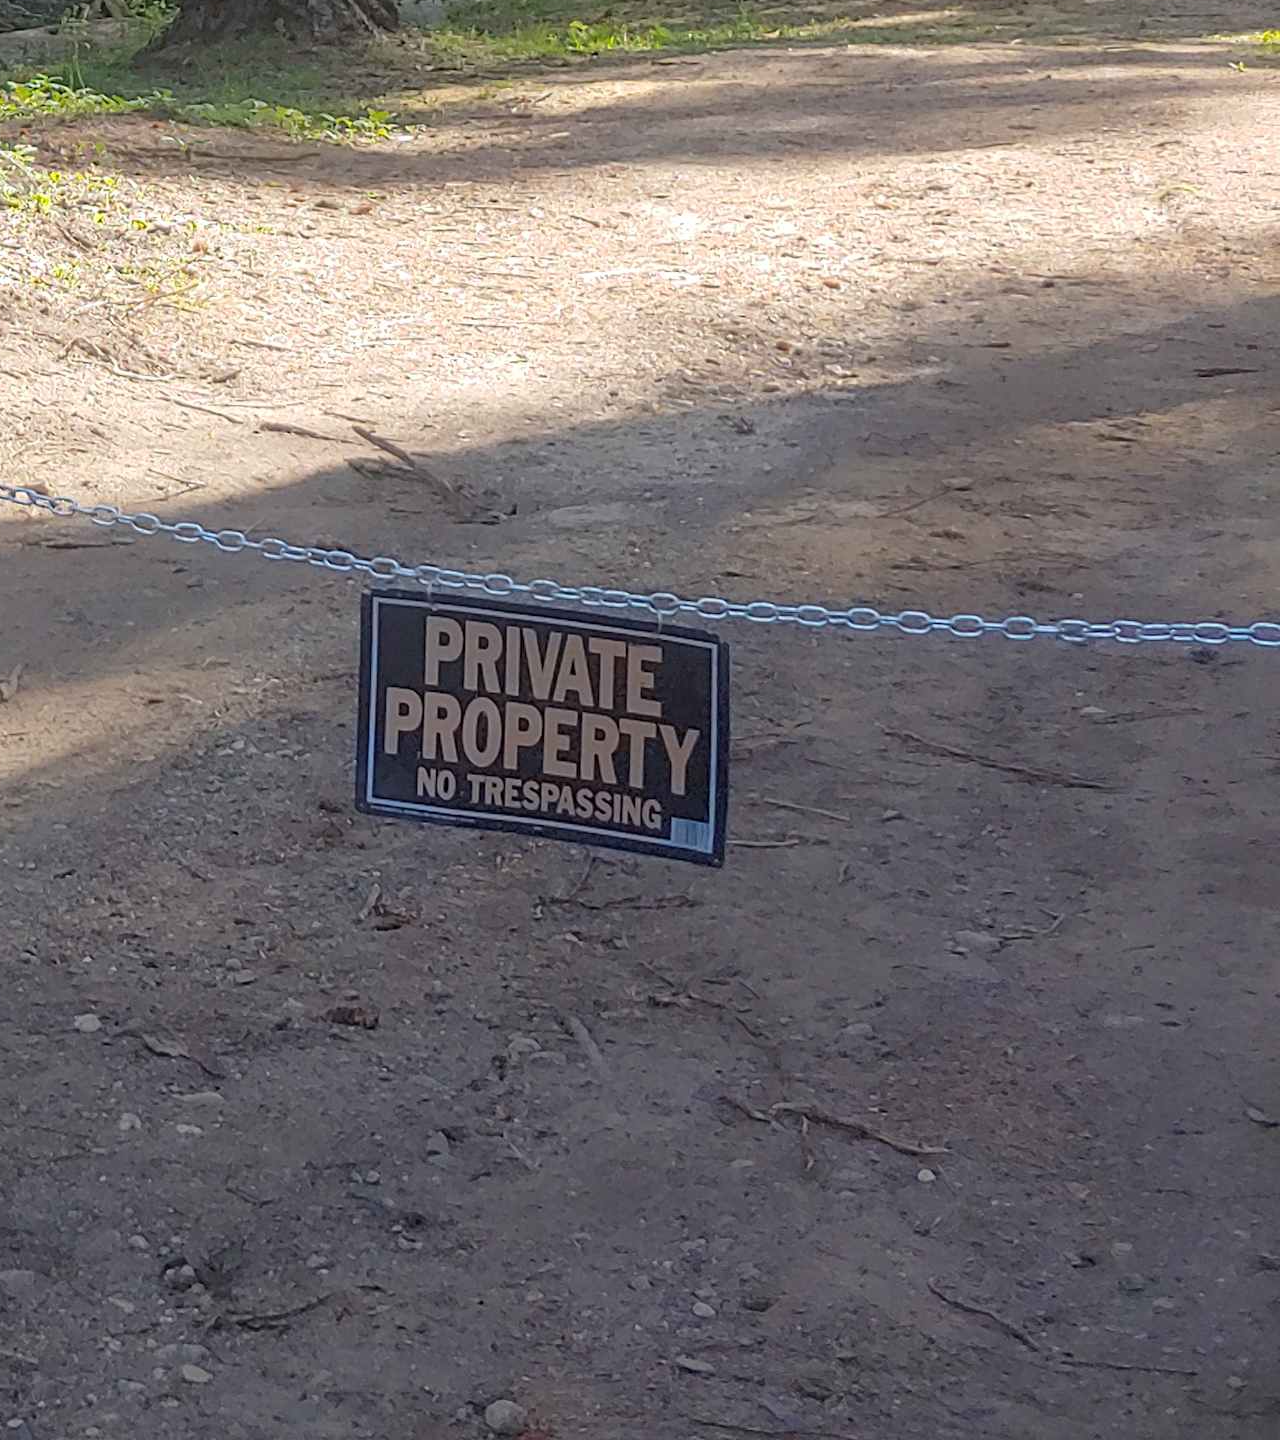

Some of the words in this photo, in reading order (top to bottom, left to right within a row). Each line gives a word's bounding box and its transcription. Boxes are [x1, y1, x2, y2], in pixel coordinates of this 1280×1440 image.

[424, 615, 663, 718] PRIVATE
[384, 686, 701, 795] PROPERTY
[416, 766, 457, 801] NO
[466, 773, 662, 830] TRESPASSING
